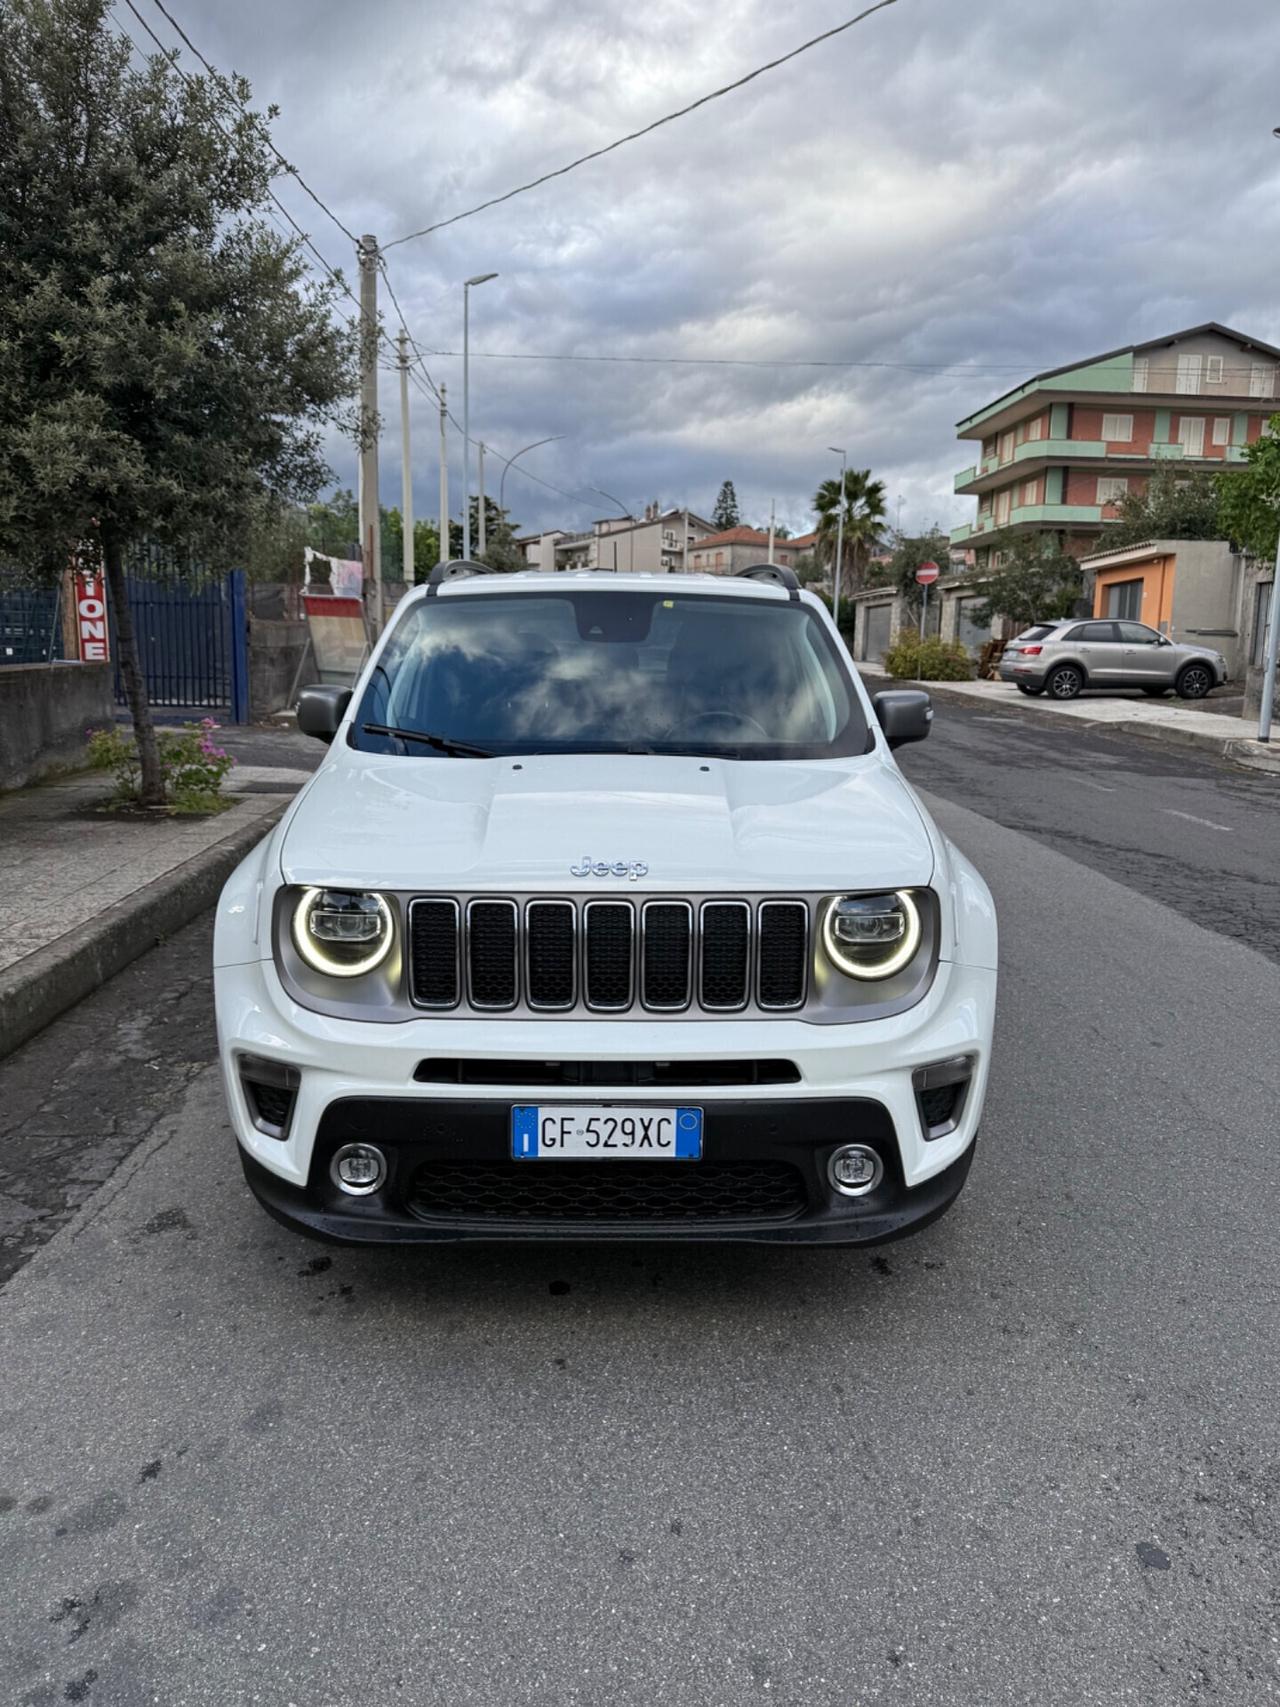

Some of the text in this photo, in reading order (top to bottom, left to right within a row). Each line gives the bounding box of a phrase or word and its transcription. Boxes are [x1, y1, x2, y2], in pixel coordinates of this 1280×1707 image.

[570, 856, 648, 881] Jeep
[541, 1117, 672, 1148] GF 529XC
